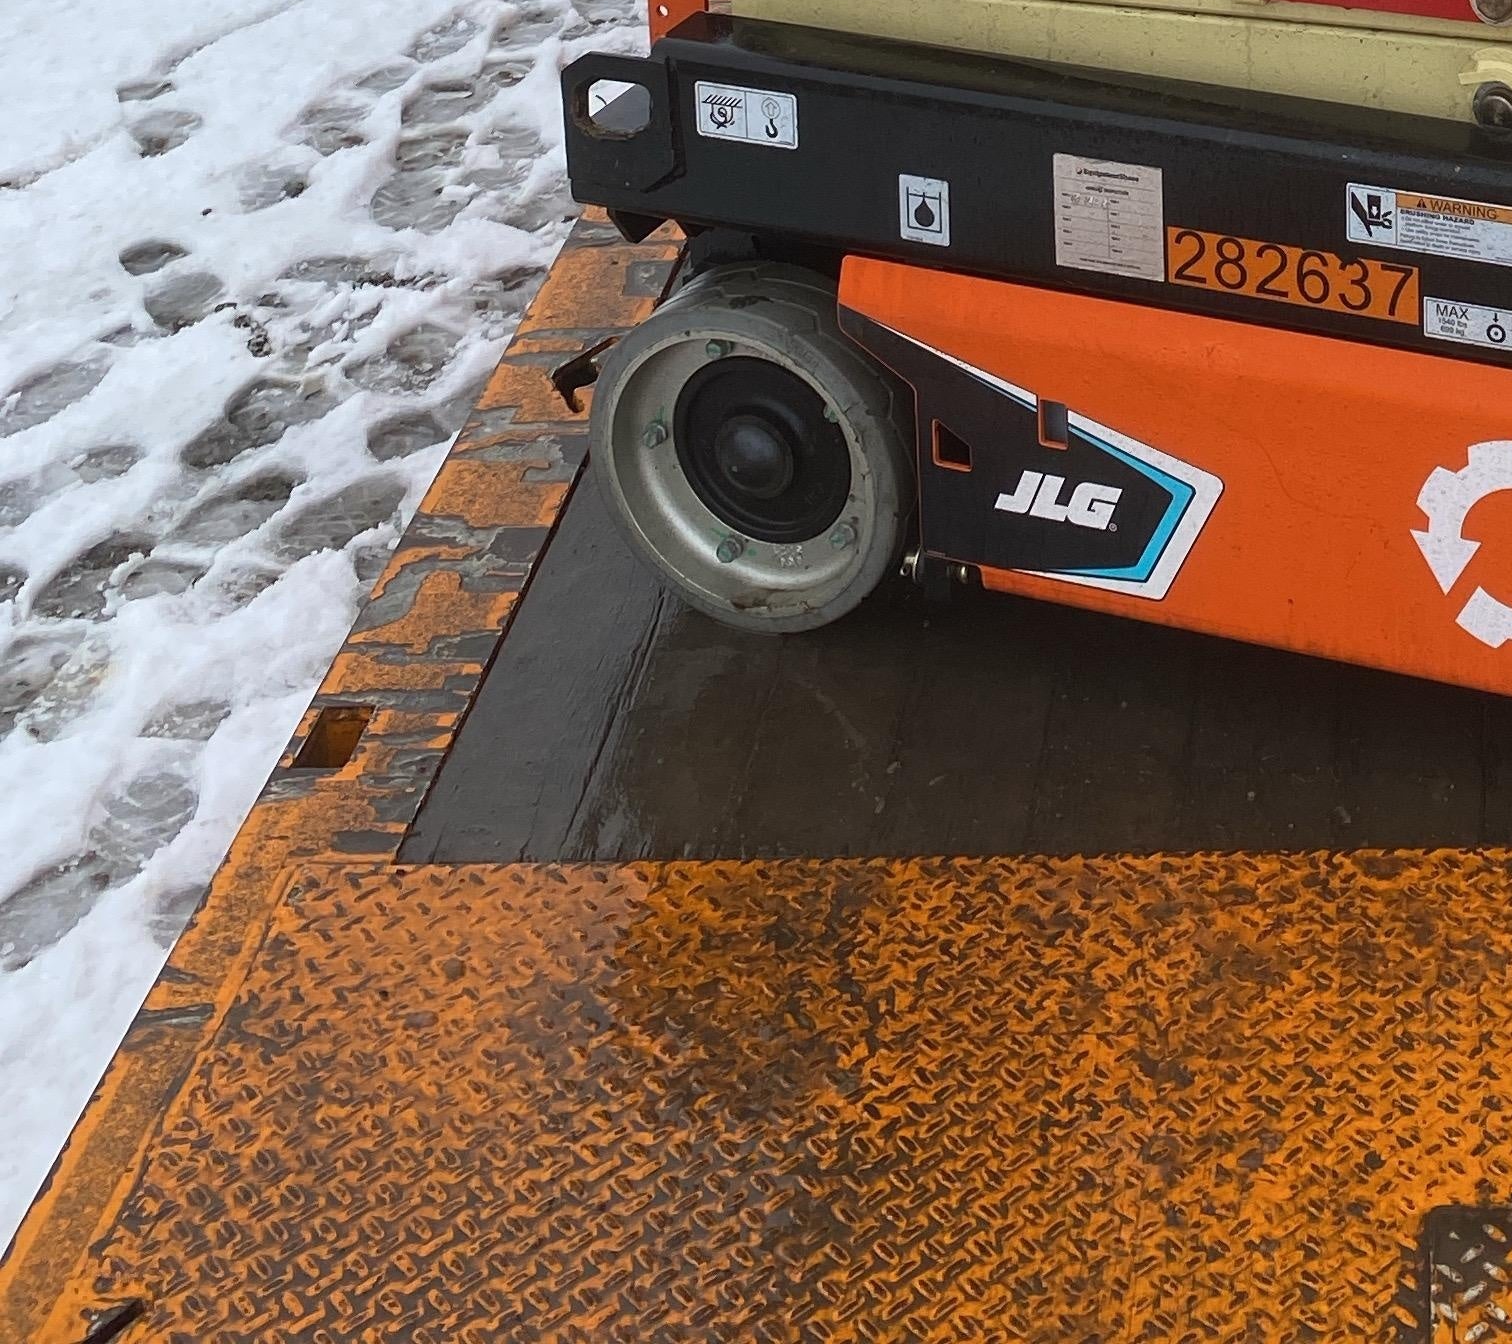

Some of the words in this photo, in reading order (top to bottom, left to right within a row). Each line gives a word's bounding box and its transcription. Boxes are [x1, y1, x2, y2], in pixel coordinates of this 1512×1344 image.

[1429, 198, 1498, 220] WARNING
[1442, 214, 1476, 226] HAZARD
[1173, 229, 1415, 317] 282637
[1435, 303, 1470, 321] MAX
[993, 469, 1123, 531] JLG
